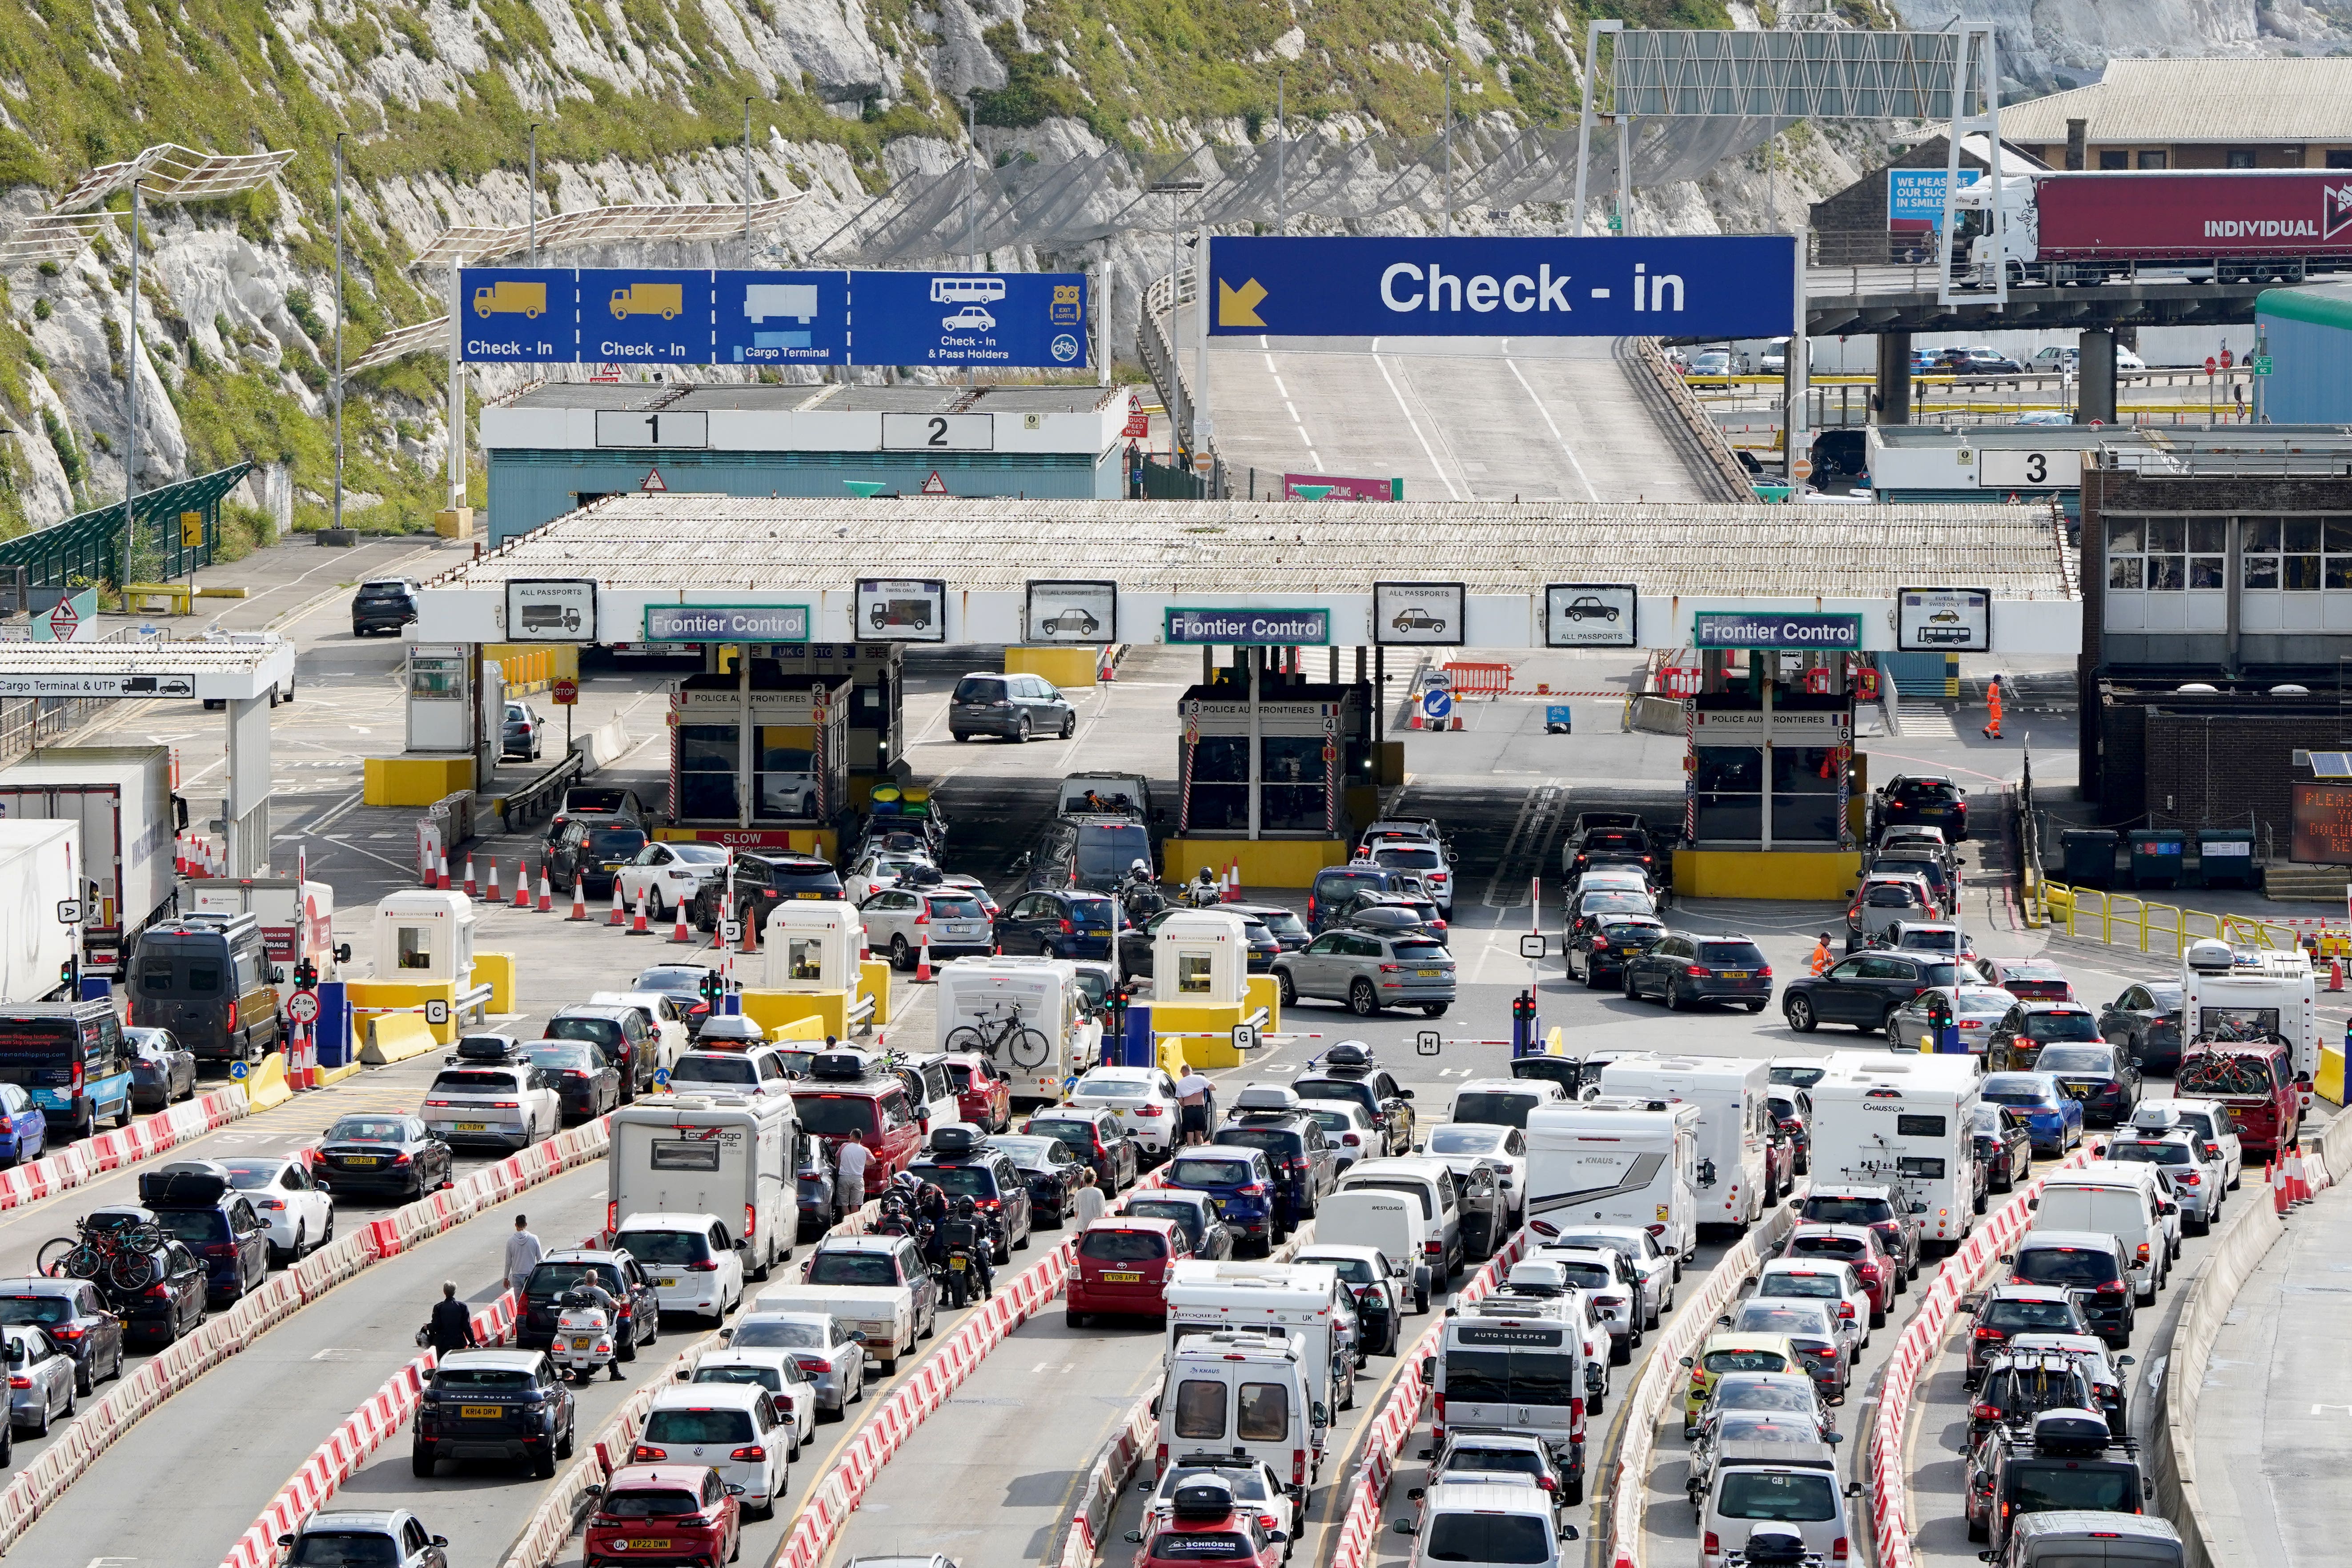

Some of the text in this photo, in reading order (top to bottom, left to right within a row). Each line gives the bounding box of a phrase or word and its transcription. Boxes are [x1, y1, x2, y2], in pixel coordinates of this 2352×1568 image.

[1897, 177, 1968, 187] WE MEASRE
[1897, 188, 1921, 197] OUR
[1896, 198, 1910, 207] IN
[2204, 220, 2319, 237] INDIVIDUAL
[1380, 262, 1684, 312] Check - in
[941, 336, 975, 346] Check
[986, 337, 996, 346] In
[467, 341, 521, 355] Check
[538, 341, 553, 354] In
[601, 341, 654, 355] Check
[671, 343, 686, 356] In
[745, 348, 829, 359] Cargo Terminal
[928, 349, 1009, 359] & Pass Holders
[646, 414, 658, 443] 1
[928, 417, 947, 445] 2
[2027, 453, 2047, 483] 3
[652, 615, 802, 632] Frontier Control
[1172, 618, 1322, 636] Frontier Control
[1702, 622, 1854, 640] Frontier Control
[779, 647, 848, 656] UK CSTOS
[0, 681, 116, 691] Cargo Terminal & UTP
[670, 682, 675, 692] 1
[814, 685, 823, 696] 2
[555, 688, 575, 696] STOP
[1191, 702, 1199, 712] 3
[1686, 700, 1694, 711] 5
[1325, 719, 1334, 730] 4
[1772, 715, 1825, 723] RONTIERES
[1841, 728, 1848, 739] 6
[2310, 822, 2352, 837] DOCU
[723, 833, 762, 844] SLOW
[64, 907, 75, 917] A
[726, 927, 735, 935] D
[432, 1007, 442, 1017] C
[1239, 1031, 1248, 1042] G
[1424, 1038, 1433, 1048] H
[1863, 1103, 1904, 1112] CHAUSSON
[1772, 1476, 1783, 1484] GB
